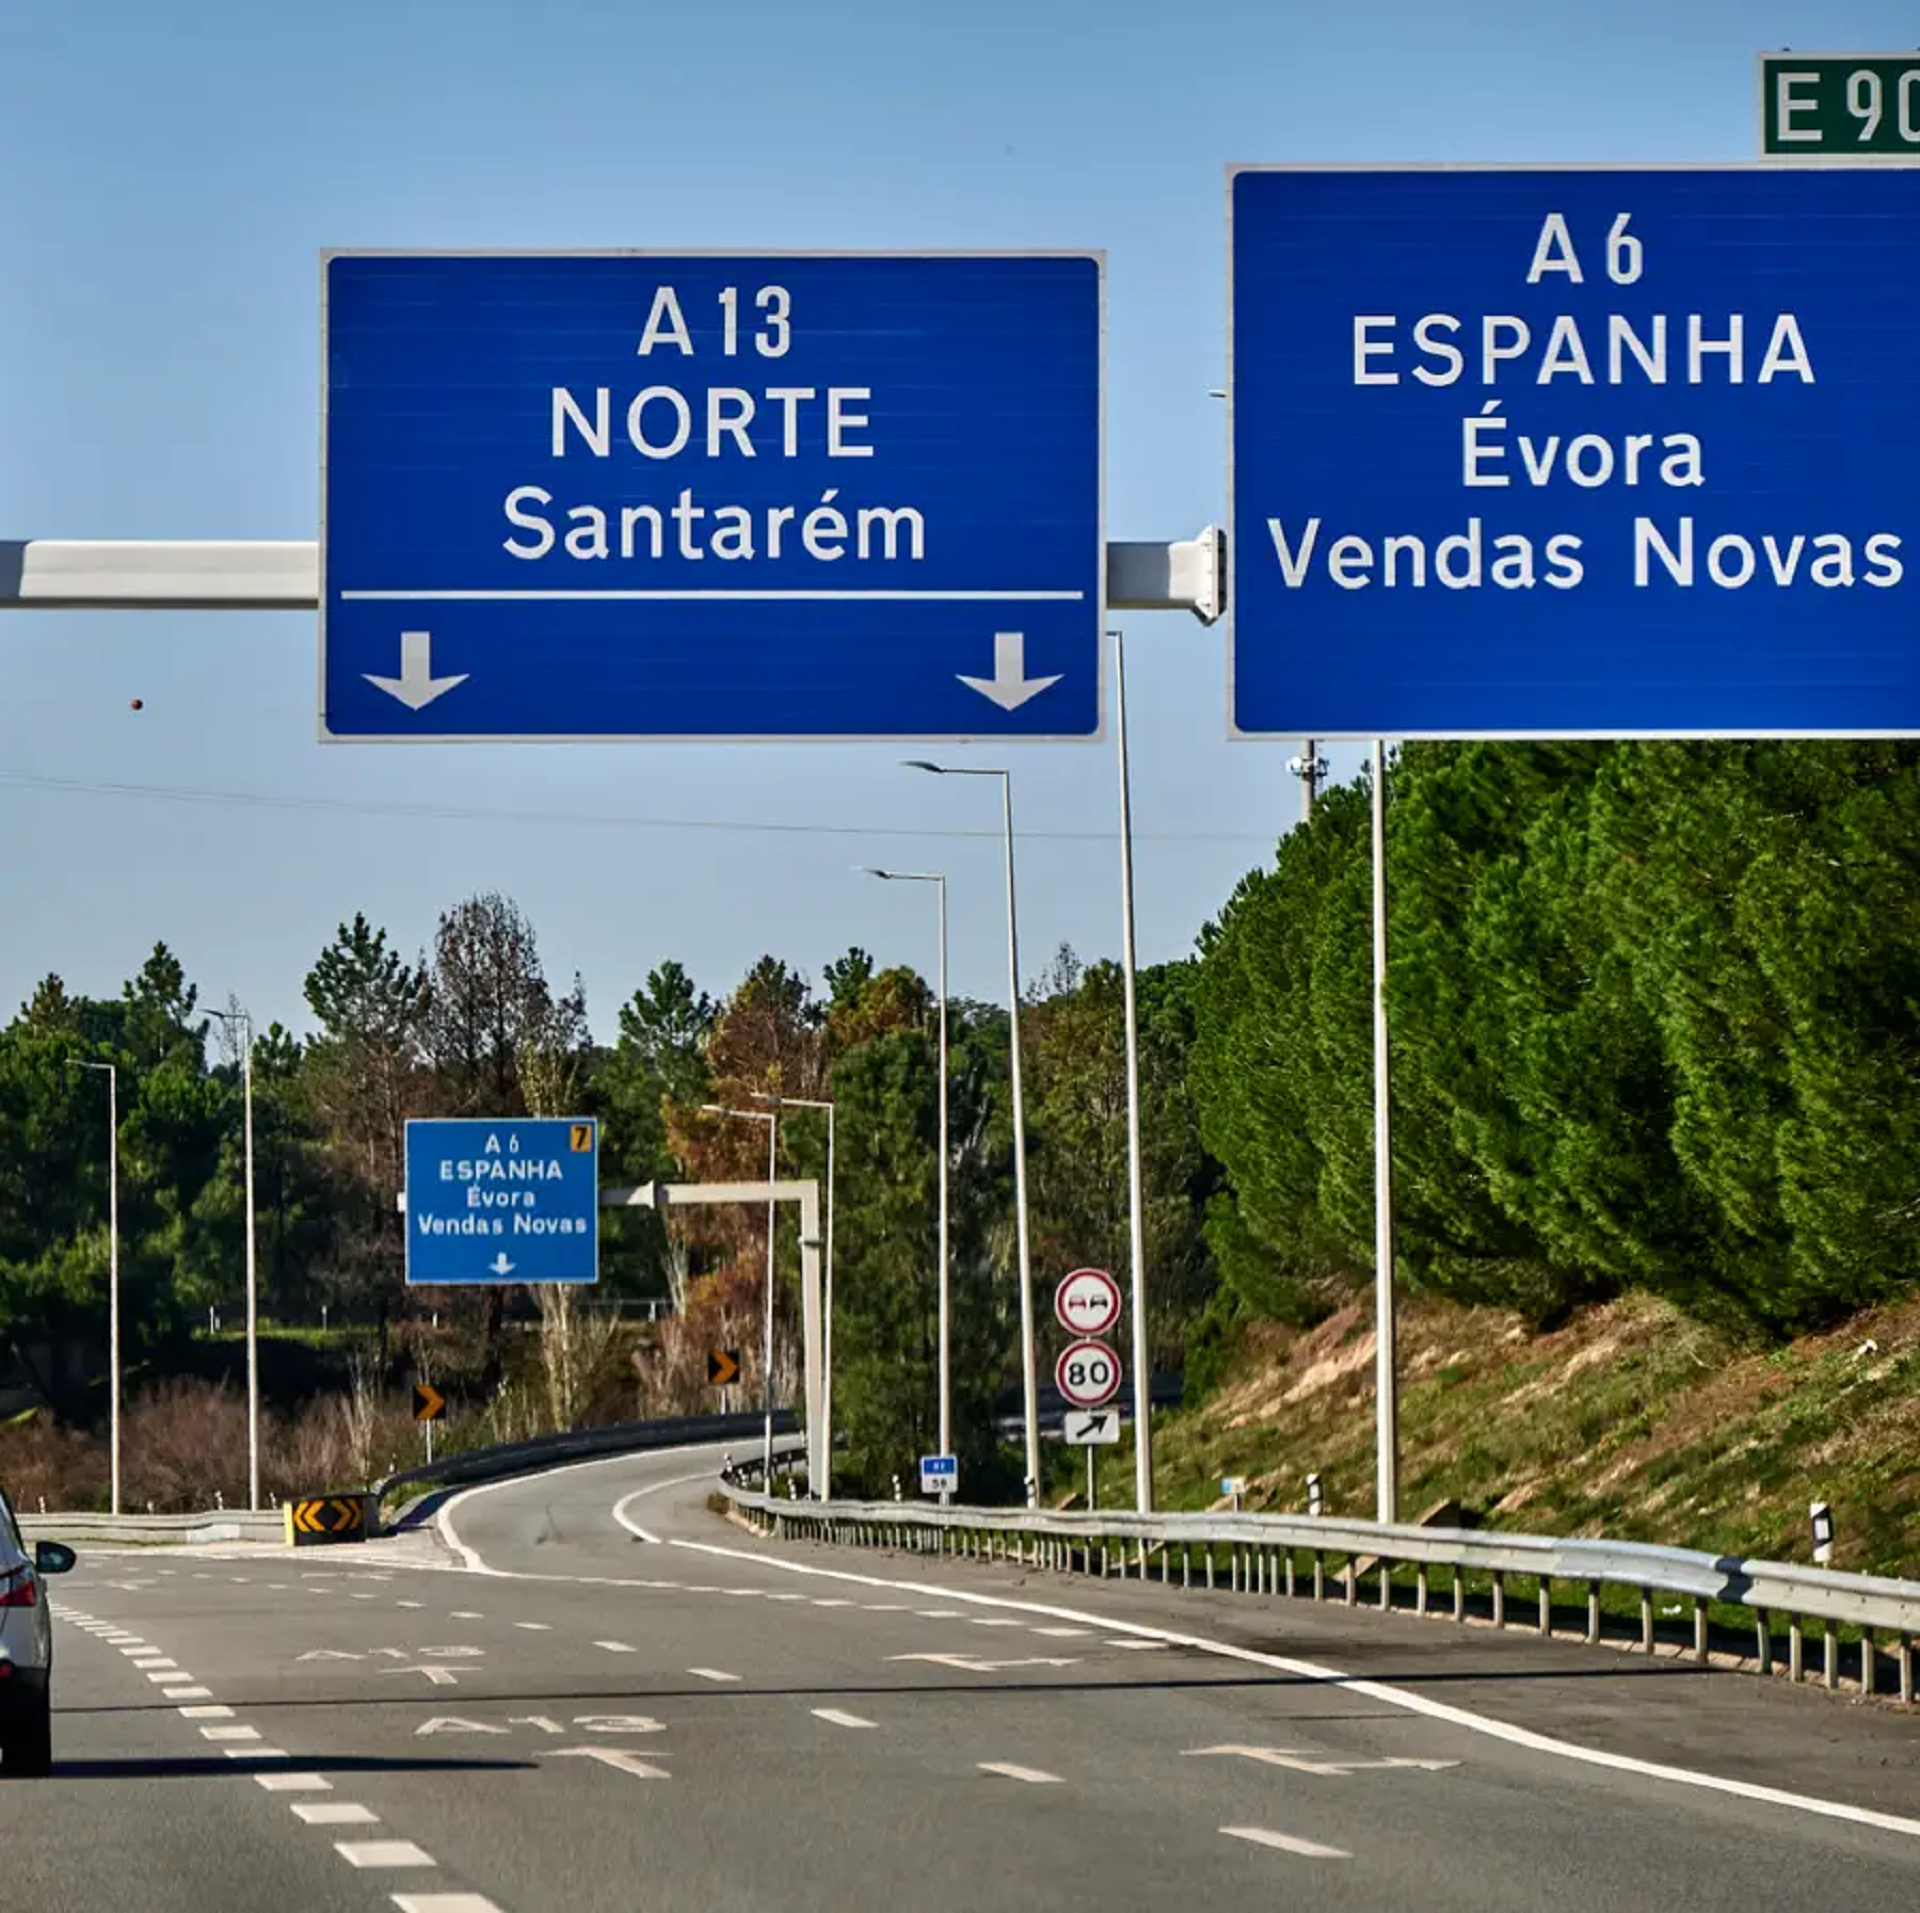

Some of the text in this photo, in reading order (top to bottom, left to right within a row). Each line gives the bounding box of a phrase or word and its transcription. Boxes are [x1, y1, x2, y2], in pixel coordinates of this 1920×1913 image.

[1354, 313, 1815, 387] ESPANHA
[552, 385, 874, 459] NORTE
[1463, 400, 1706, 487] Évora
[502, 485, 924, 561] Santarém
[1267, 516, 1904, 589] Vendas Novas
[573, 1126, 588, 1150] 7
[440, 1160, 563, 1180] ESPANHA
[467, 1183, 536, 1208] Évora
[418, 1213, 587, 1235] Vendas Novas
[1067, 1360, 1110, 1386] 80
